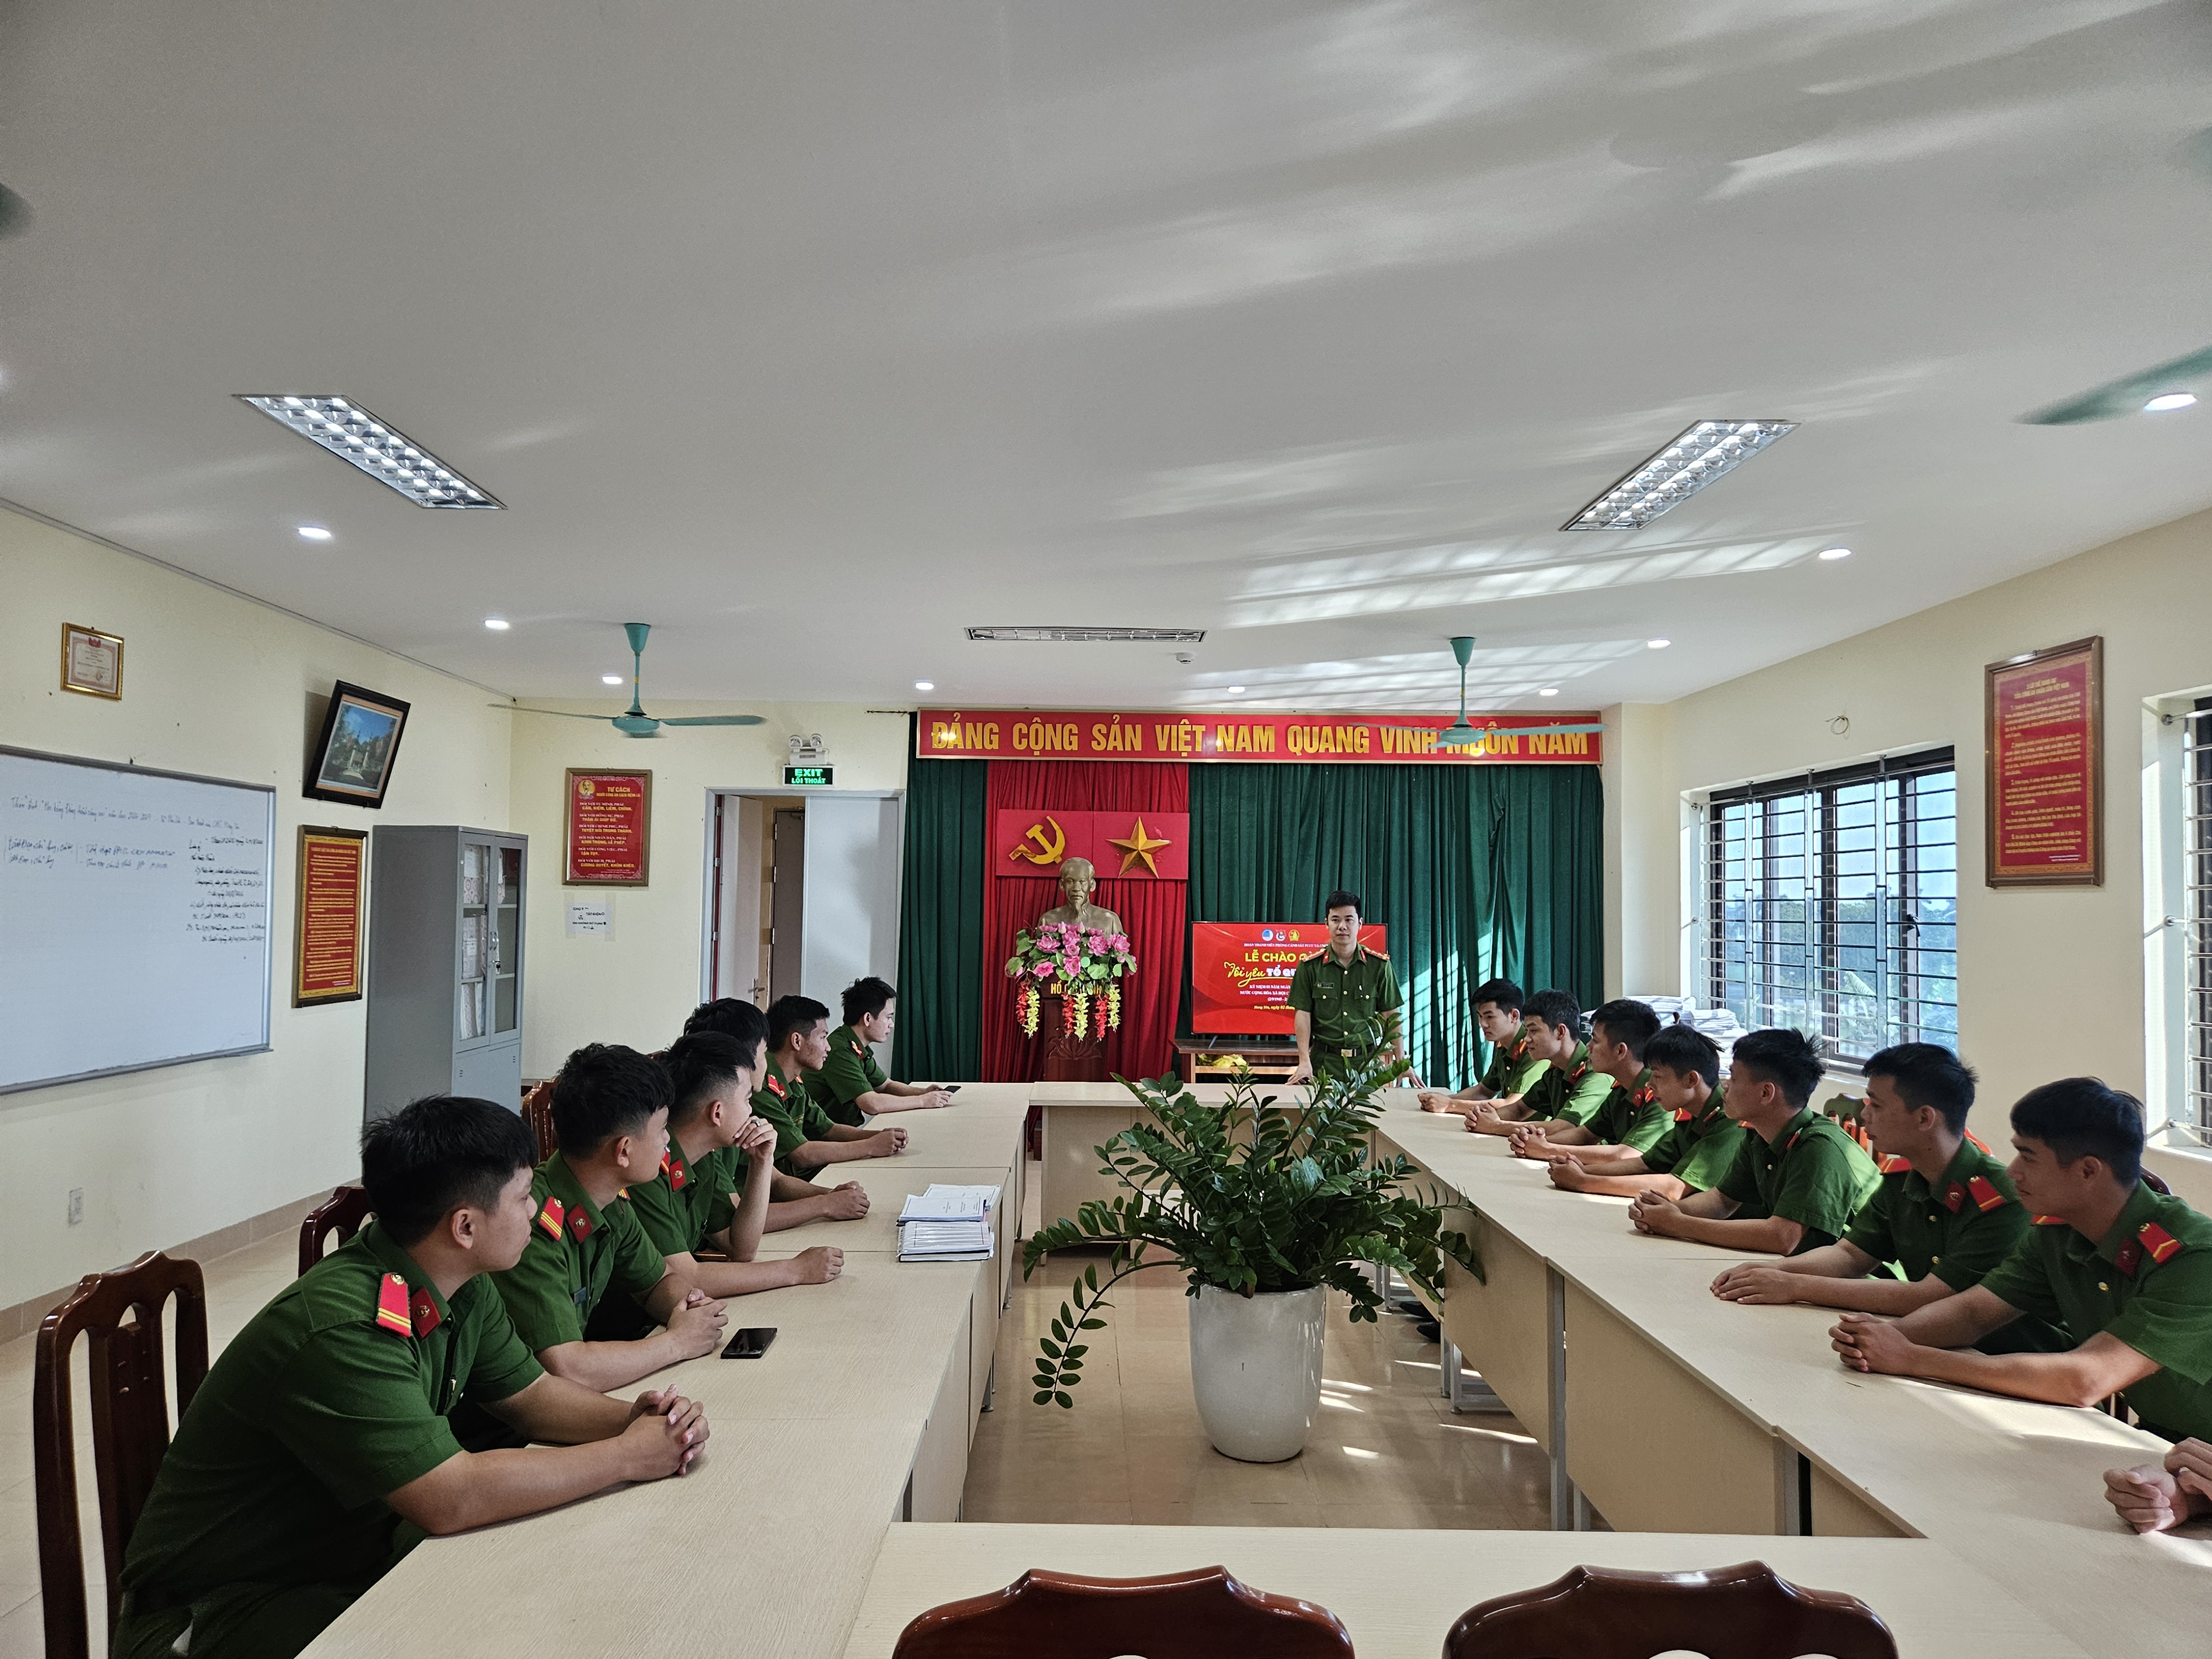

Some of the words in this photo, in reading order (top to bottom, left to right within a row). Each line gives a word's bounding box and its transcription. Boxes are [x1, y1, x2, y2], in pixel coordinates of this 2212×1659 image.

[931, 712, 999, 750] ĐẢNG
[1013, 717, 1078, 755] CỘNG
[1091, 714, 1142, 751] SẢN
[1155, 719, 1206, 757] VIỆT
[1217, 724, 1275, 752] NAM
[1287, 726, 1369, 755] QUANG
[1380, 727, 1437, 754] VINH
[1528, 722, 1588, 754] NĂM
[791, 775, 803, 784] LỐI
[1245, 949, 1259, 962] LỄ
[1262, 951, 1296, 962] CHÀO
[1238, 967, 1266, 987] yêu
[1266, 964, 1281, 977] TỔ
[1282, 968, 1296, 977] QU
[1051, 980, 1062, 994] HỒ
